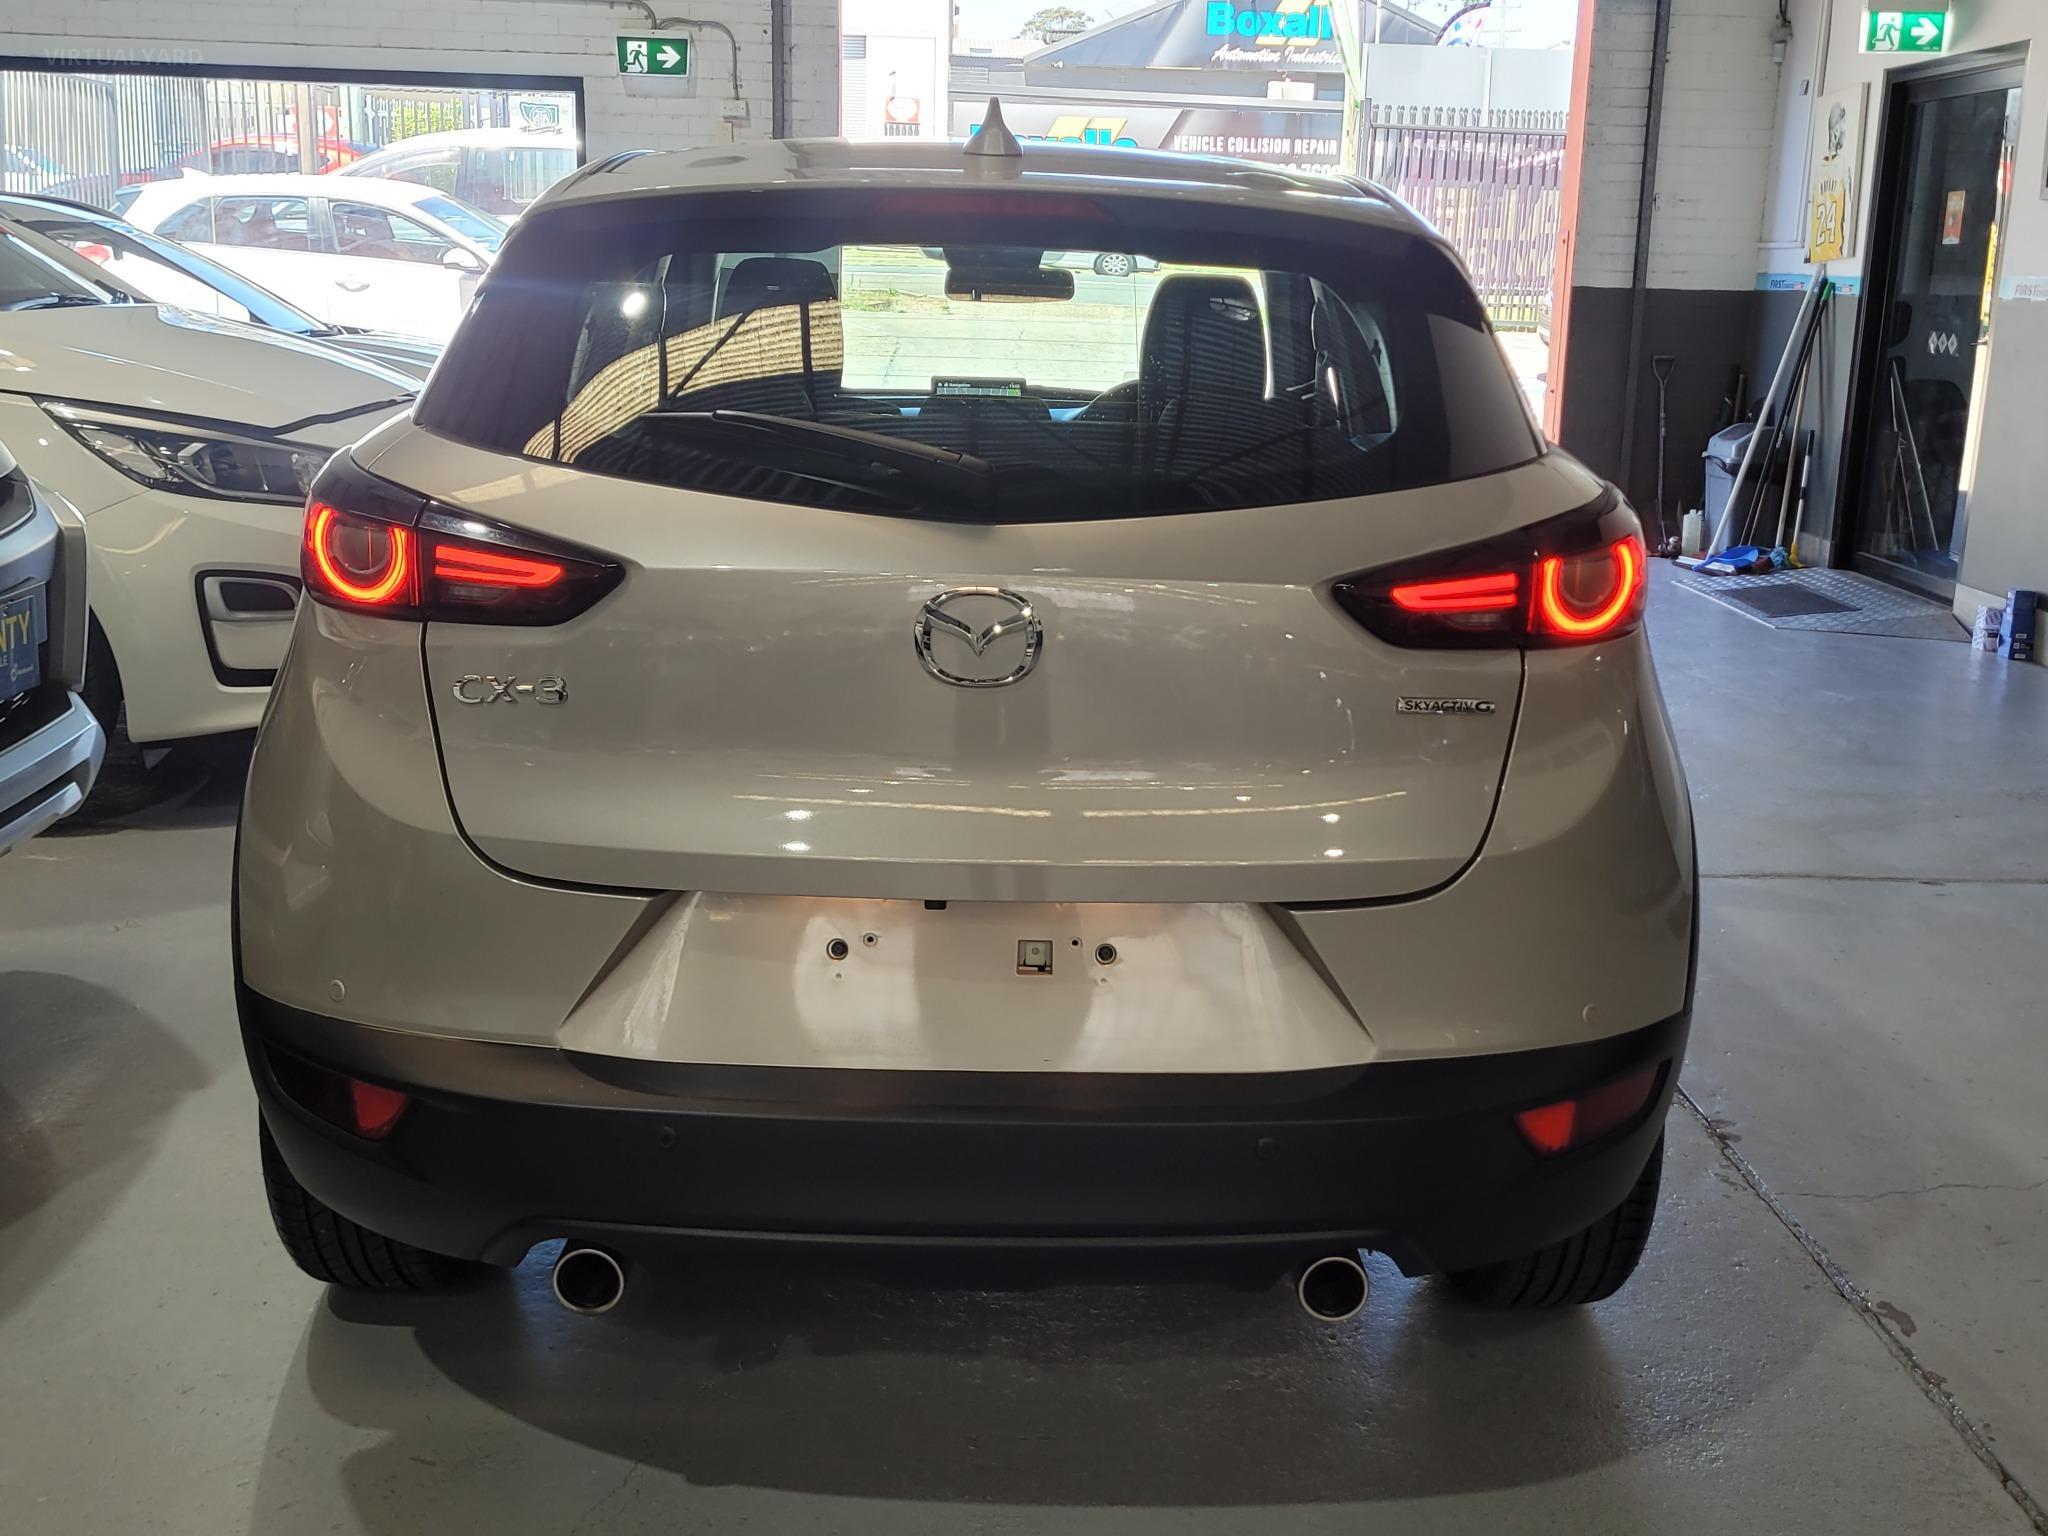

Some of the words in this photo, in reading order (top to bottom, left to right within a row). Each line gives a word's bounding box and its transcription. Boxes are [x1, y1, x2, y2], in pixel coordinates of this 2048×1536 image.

[1211, 43, 1281, 63] Automotive
[1285, 46, 1343, 64] Industrie
[1173, 135, 1224, 152] VEHICLE
[1228, 137, 1290, 154] COLLISION
[1294, 139, 1337, 155] REPAIR
[1816, 201, 1837, 247] 24
[453, 674, 568, 705] CX-3
